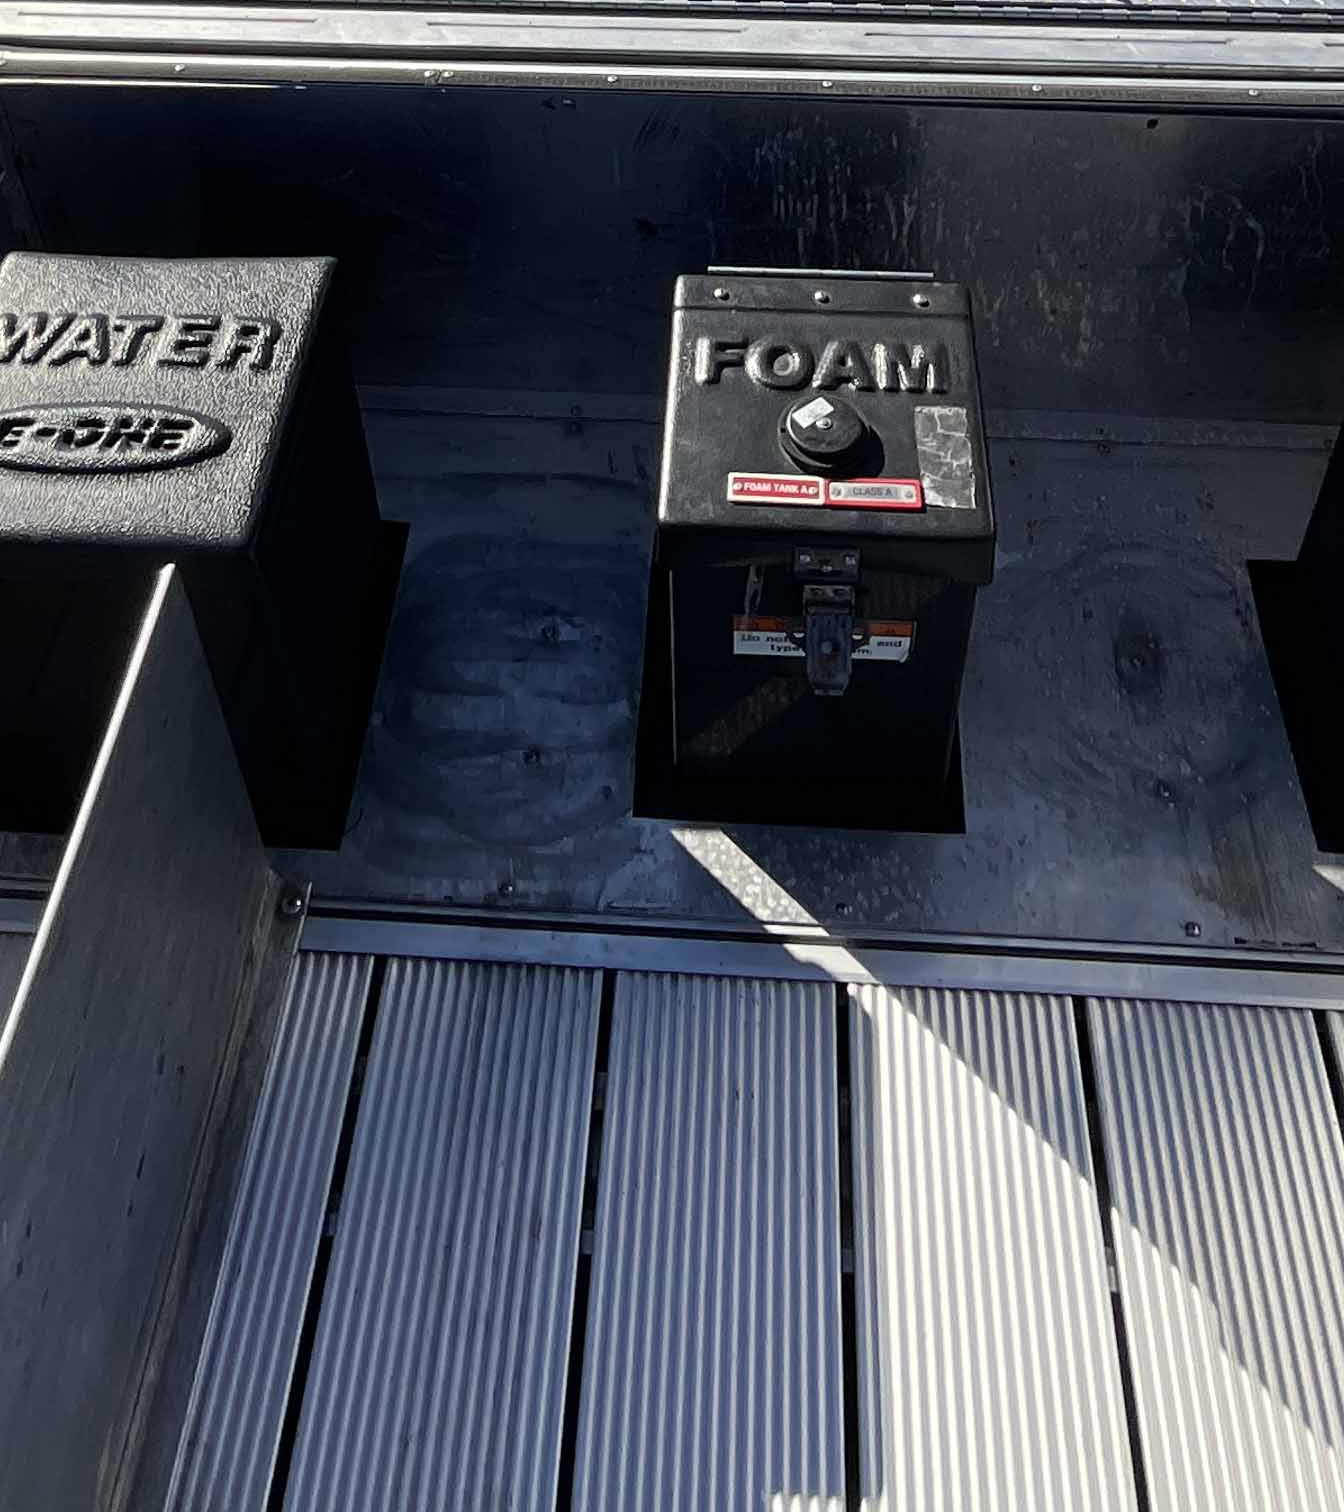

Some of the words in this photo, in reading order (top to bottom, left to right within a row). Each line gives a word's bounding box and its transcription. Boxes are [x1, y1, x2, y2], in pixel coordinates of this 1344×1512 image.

[694, 337, 950, 393] FOAM
[743, 482, 771, 492] FOAM
[773, 483, 799, 493] TANK
[800, 485, 808, 494] A
[853, 487, 881, 496] CLASS
